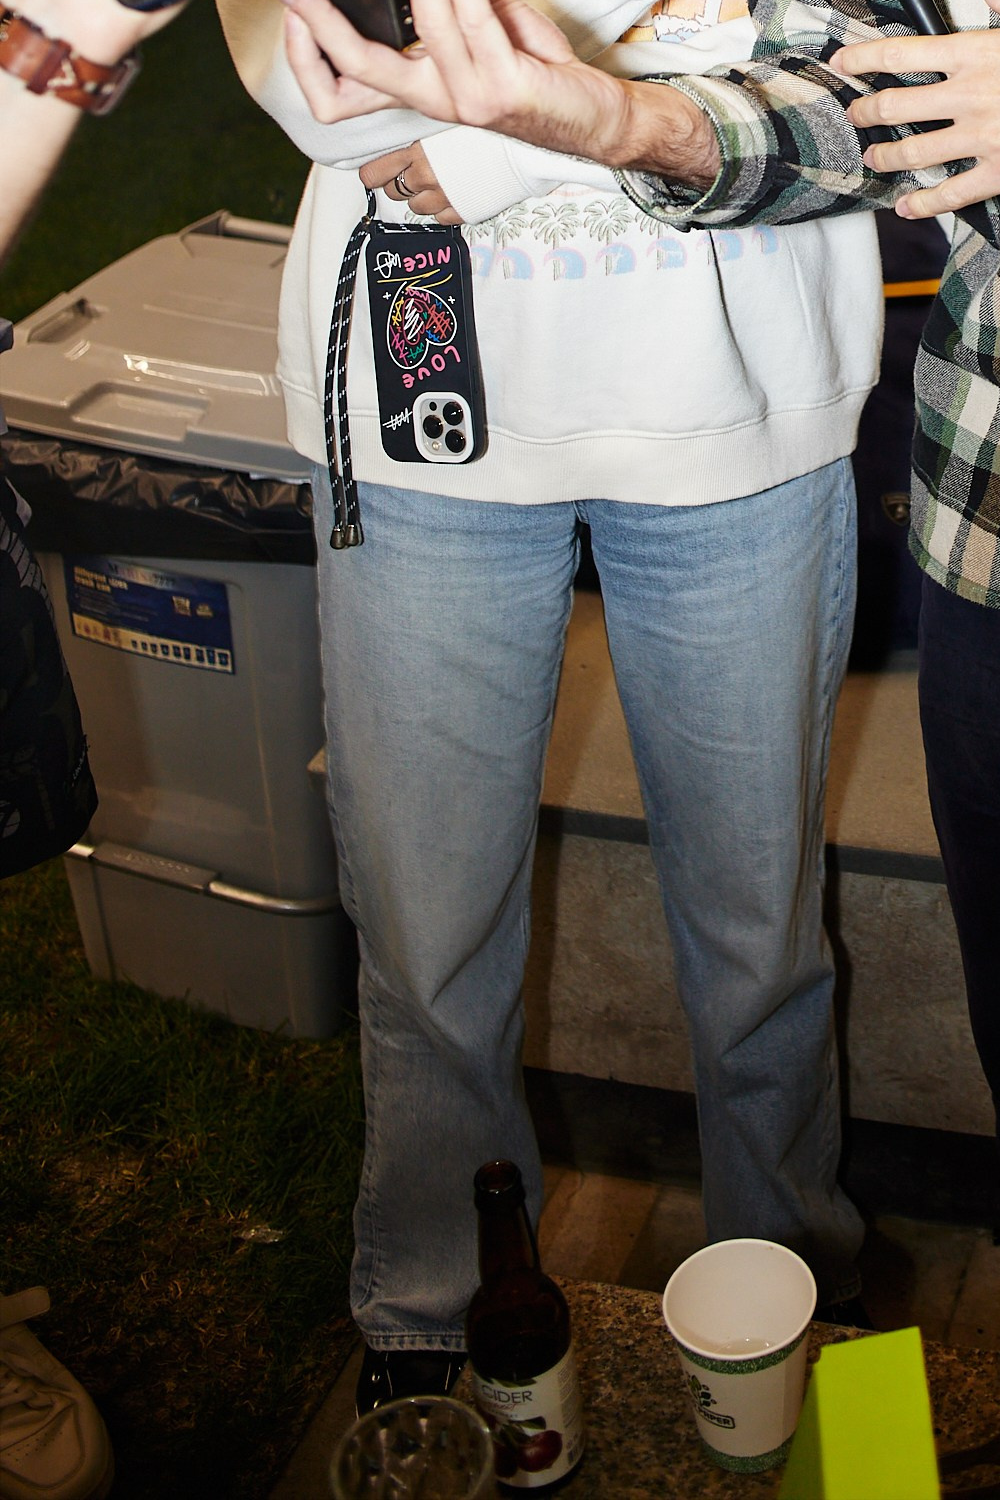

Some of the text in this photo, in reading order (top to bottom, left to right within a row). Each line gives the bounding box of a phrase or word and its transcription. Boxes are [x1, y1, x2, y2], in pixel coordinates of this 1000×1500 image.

[402, 246, 451, 273] NICE
[402, 345, 461, 389] LOVE
[480, 1384, 533, 1405] CIDER
